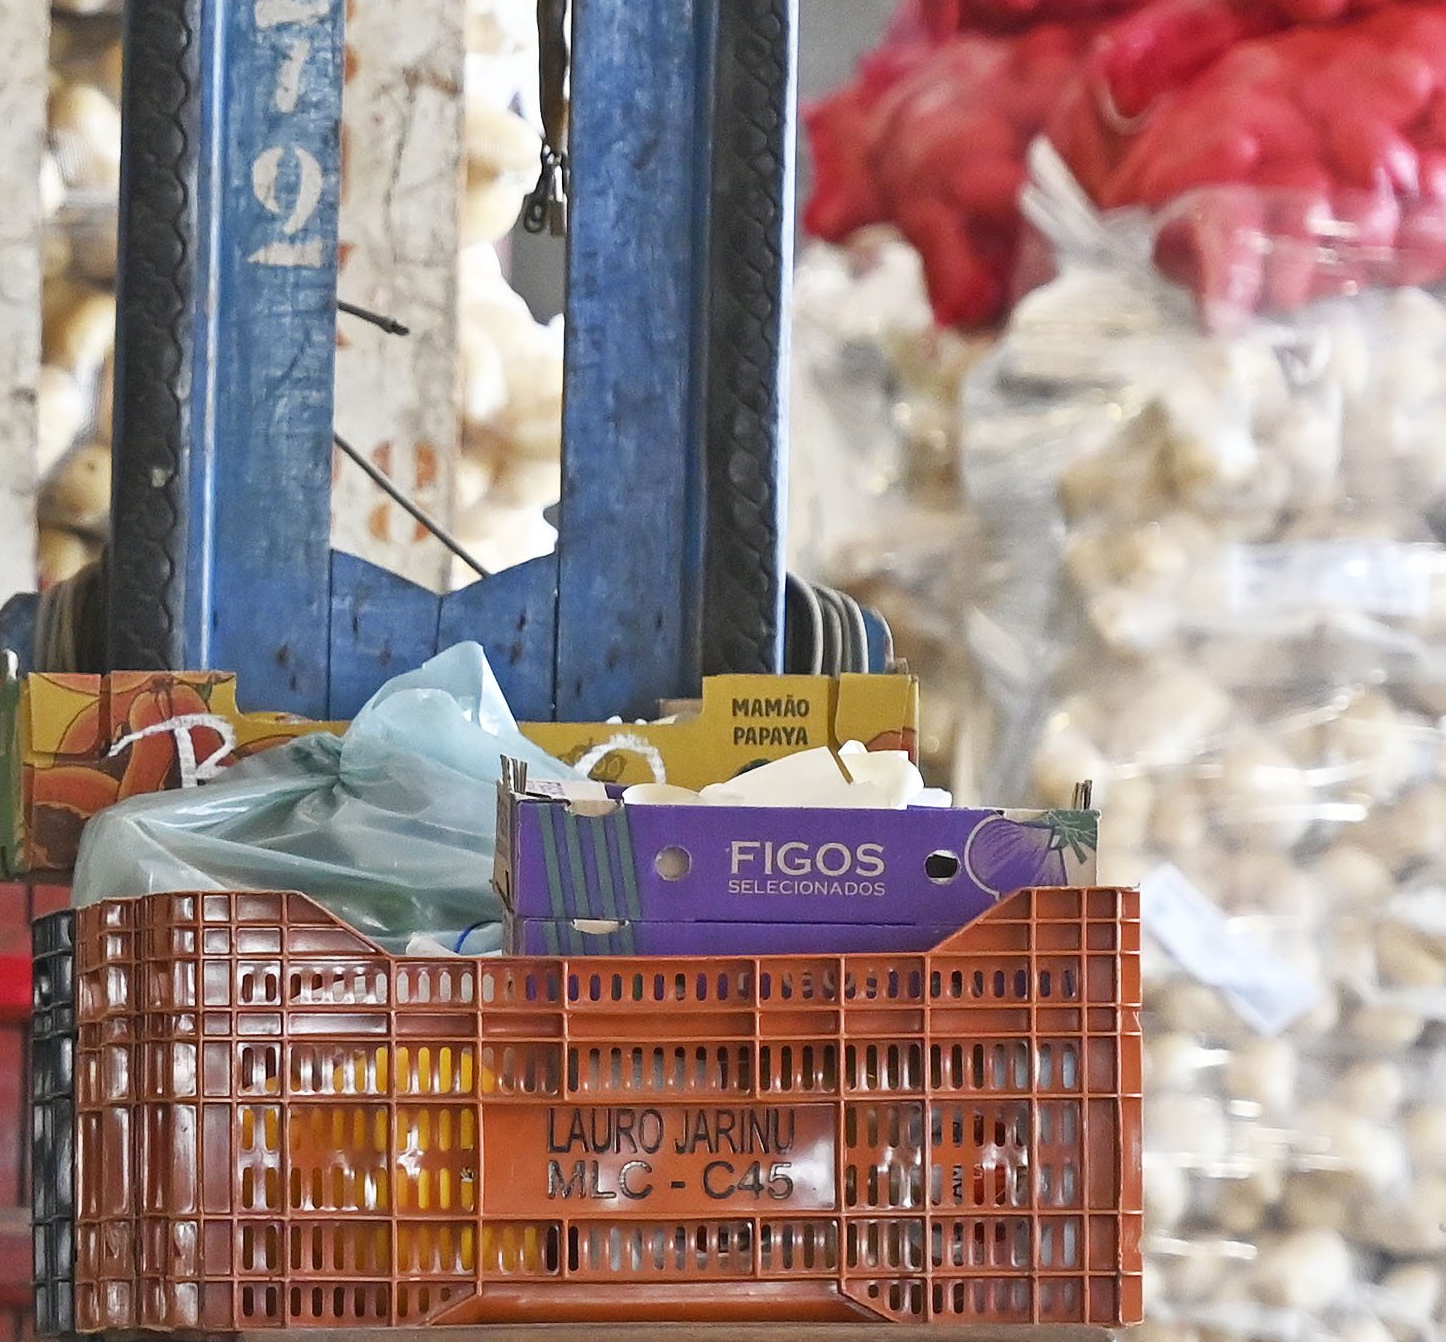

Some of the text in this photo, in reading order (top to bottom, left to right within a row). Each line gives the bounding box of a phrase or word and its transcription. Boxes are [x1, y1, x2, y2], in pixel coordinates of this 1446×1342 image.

[732, 694, 810, 719] MAMÃO
[732, 725, 809, 747] PAPAYA
[728, 839, 886, 878] FIGOS
[728, 878, 886, 898] SELECIONADOS
[547, 1108, 796, 1155] LAURO JARINU
[547, 1159, 654, 1201] MLC
[702, 1159, 795, 1201] C45
